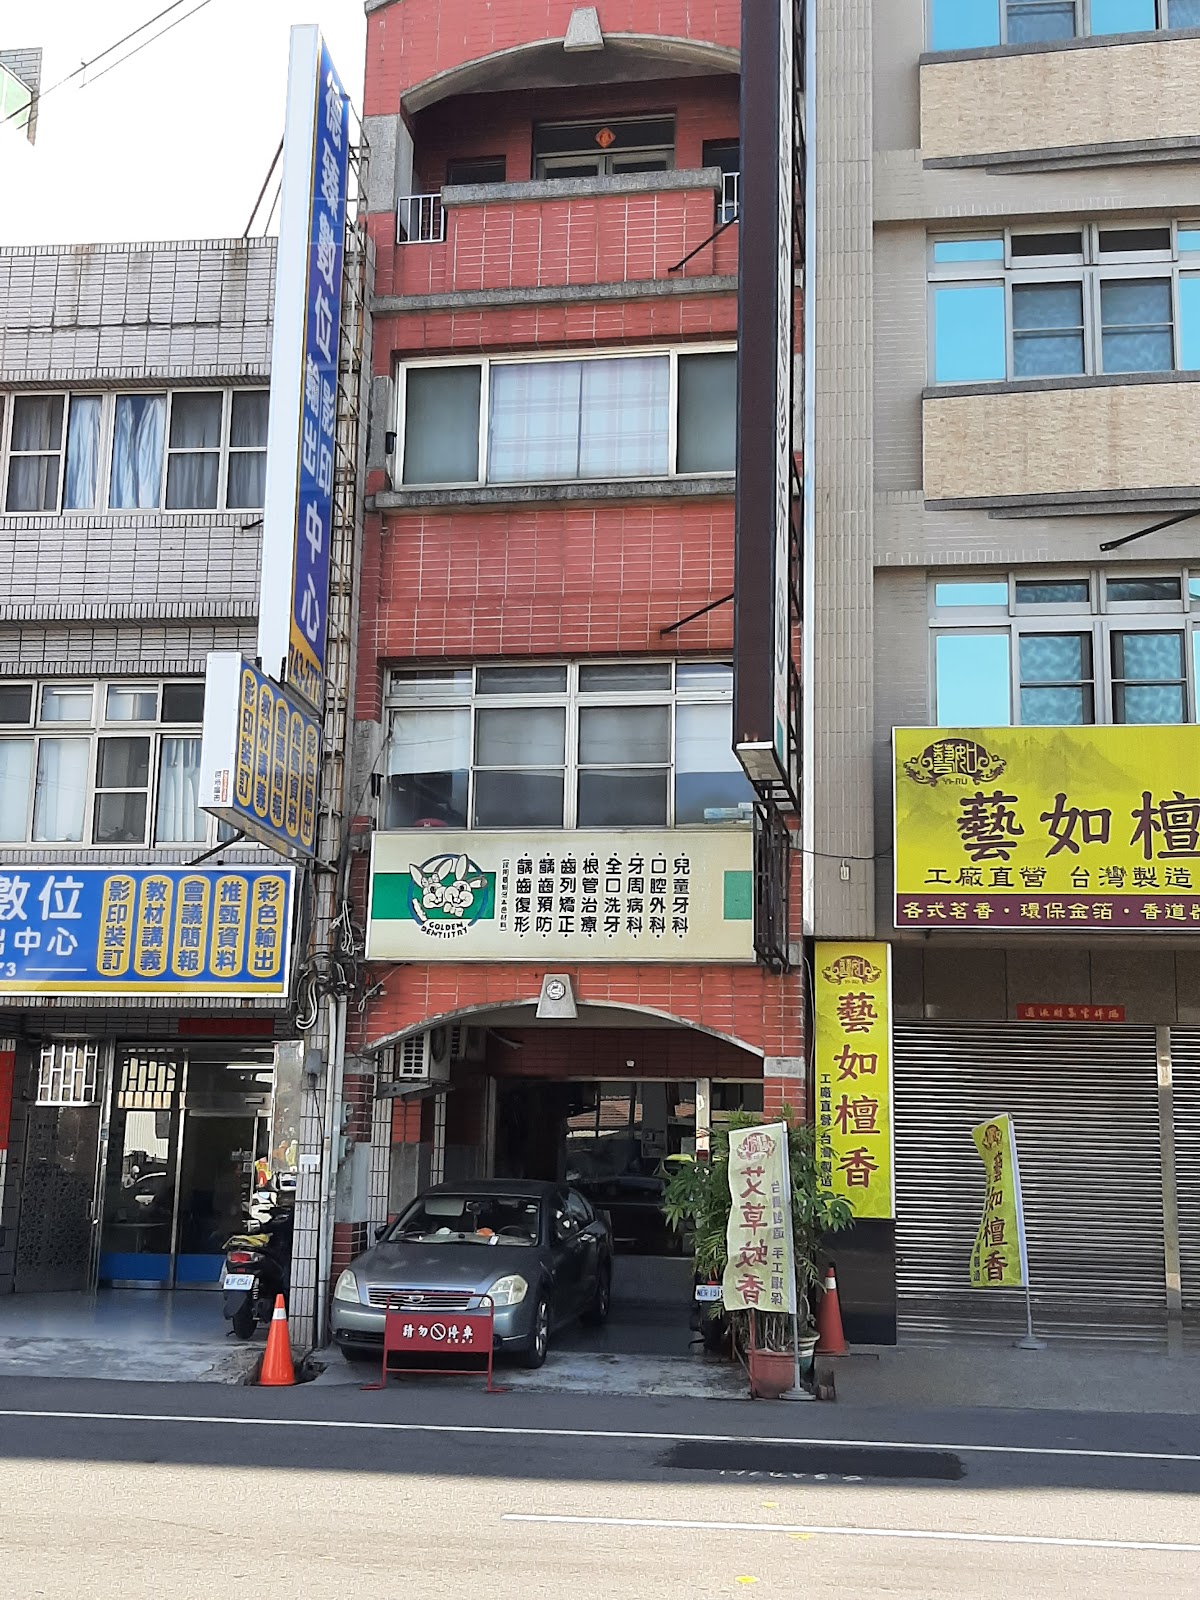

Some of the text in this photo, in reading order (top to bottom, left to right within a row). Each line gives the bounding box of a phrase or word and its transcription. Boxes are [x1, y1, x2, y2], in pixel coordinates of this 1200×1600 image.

[301, 500, 322, 642] 中心
[558, 858, 577, 933] 齒列矯正
[580, 858, 599, 933] 根管治療
[604, 858, 622, 933] 全口洗牙
[626, 858, 645, 934] 牙周病科
[649, 858, 667, 934] 口腔外科
[671, 858, 691, 934] 兒童牙科
[924, 866, 1193, 889] 工廠直營 台灣製造
[0, 926, 78, 956] 中心
[102, 880, 131, 971] 影印裝訂
[140, 880, 168, 971] 教材講義
[177, 880, 205, 971] 會議簡報
[215, 880, 242, 972] 推甄資料
[253, 880, 279, 972] 彩色輸出
[429, 921, 463, 931] GOLDEN
[834, 992, 880, 1188] 藝如檀香
